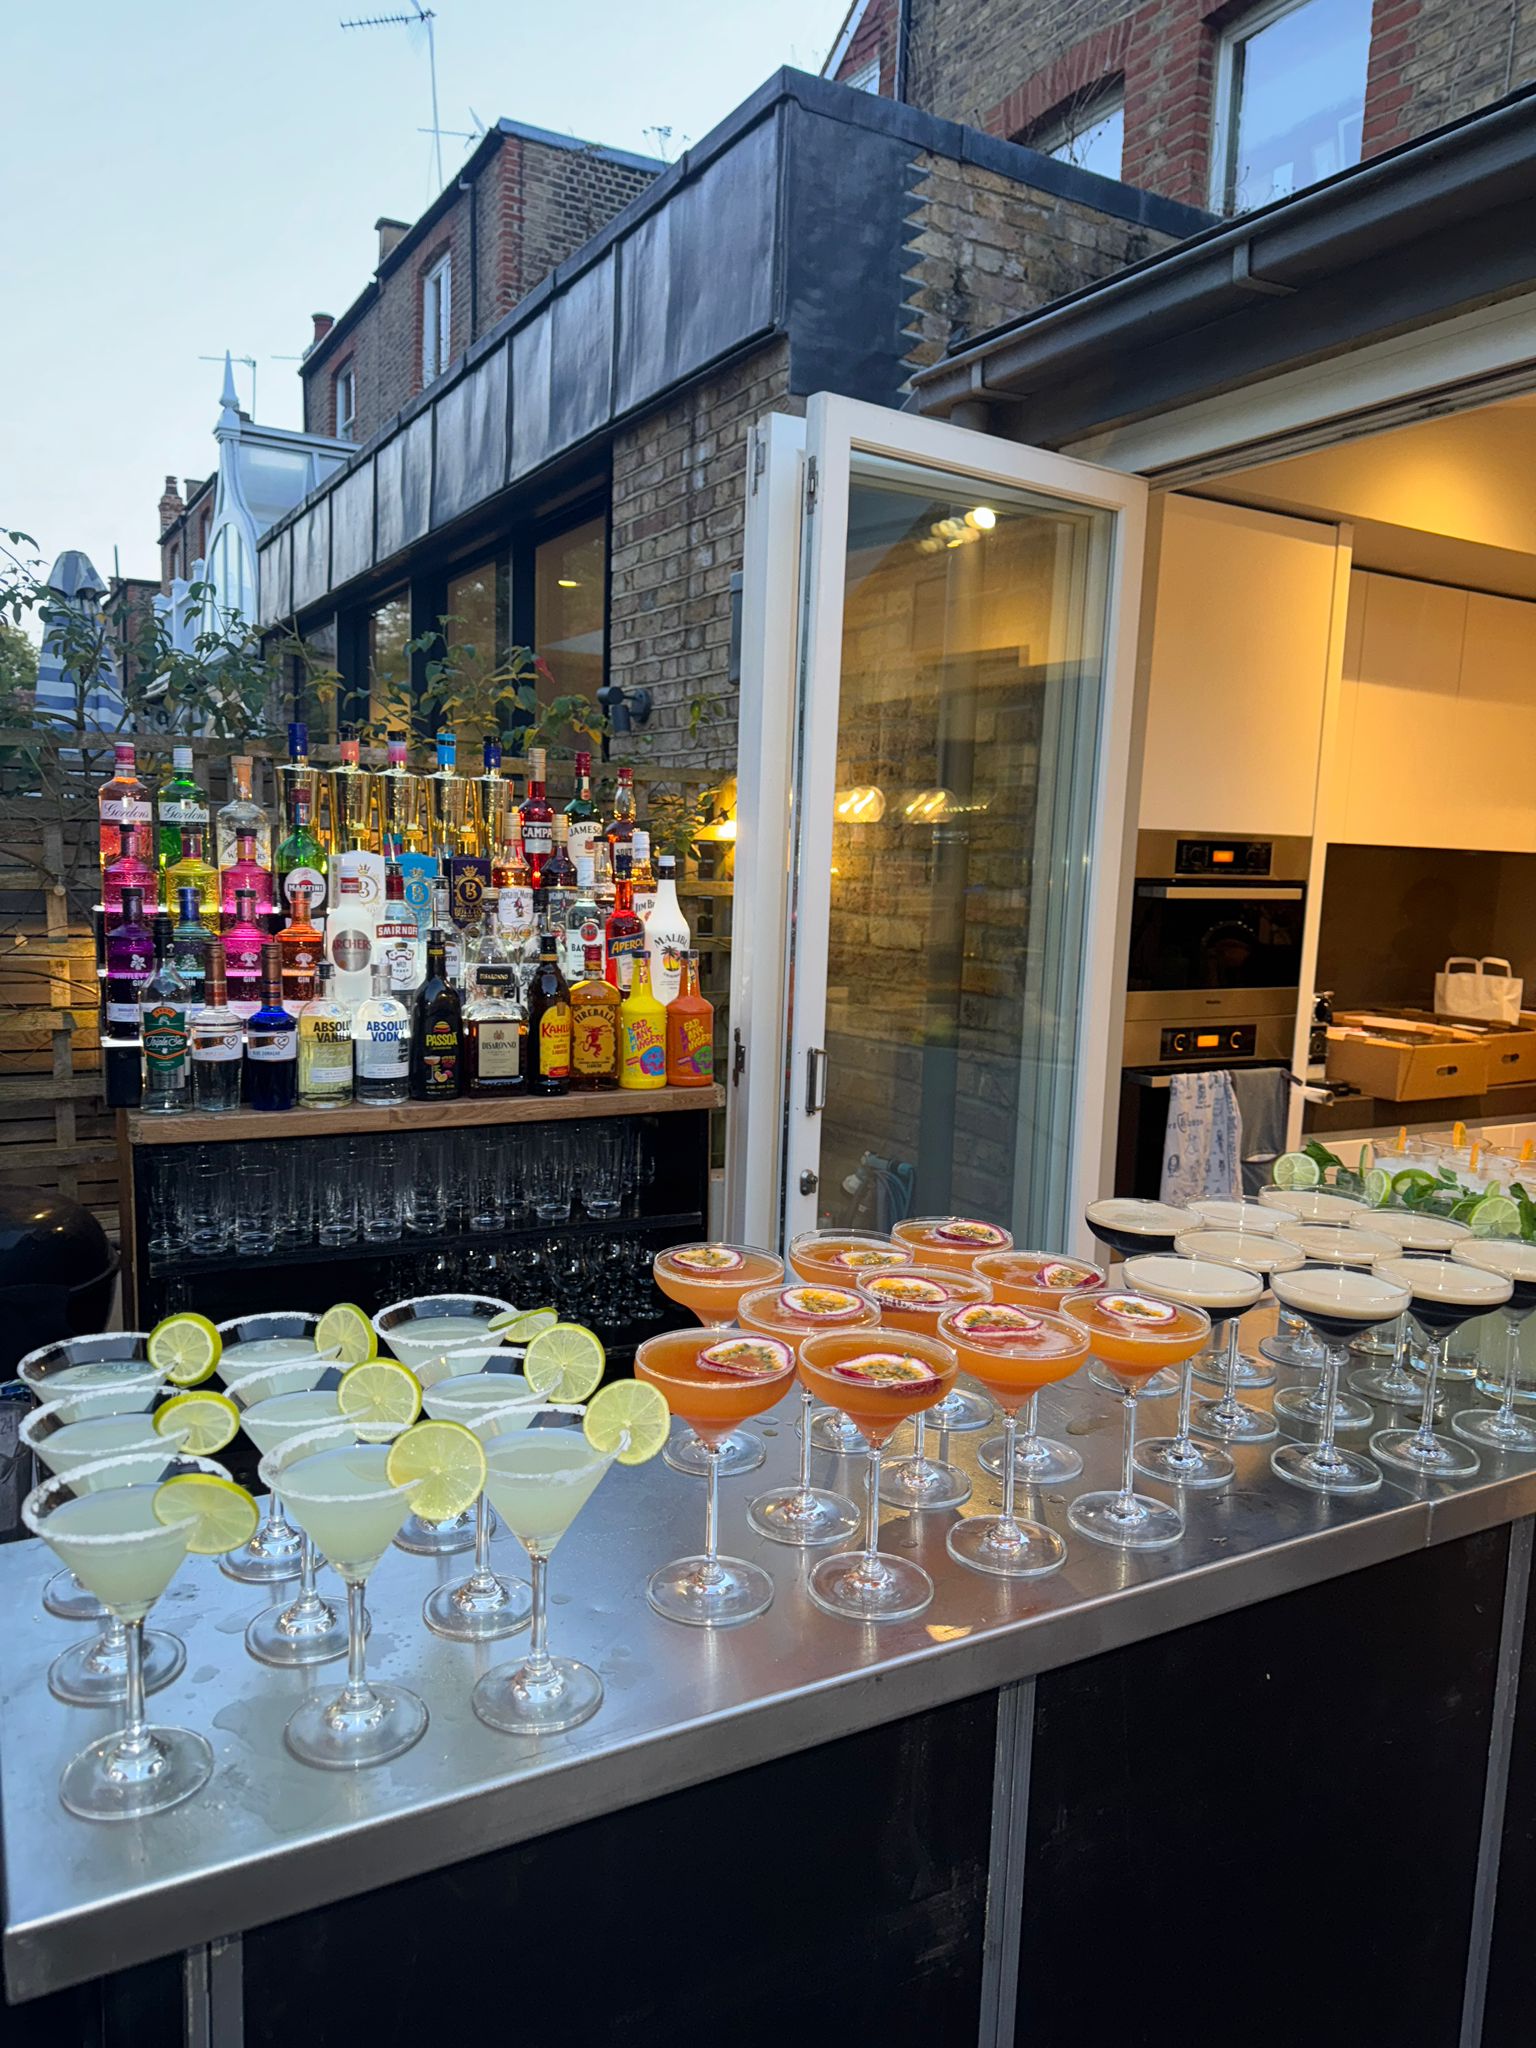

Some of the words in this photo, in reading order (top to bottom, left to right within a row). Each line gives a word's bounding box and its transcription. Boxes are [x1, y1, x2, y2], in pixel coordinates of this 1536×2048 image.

[521, 826, 553, 838] CAMPA
[288, 884, 323, 892] MARTINI
[635, 903, 647, 912] JIM
[378, 924, 418, 936] SMIRNOF
[574, 1008, 616, 1025] FIREBALL
[366, 1020, 409, 1032] ABSOLUT
[481, 1040, 517, 1050] DISARONNO
